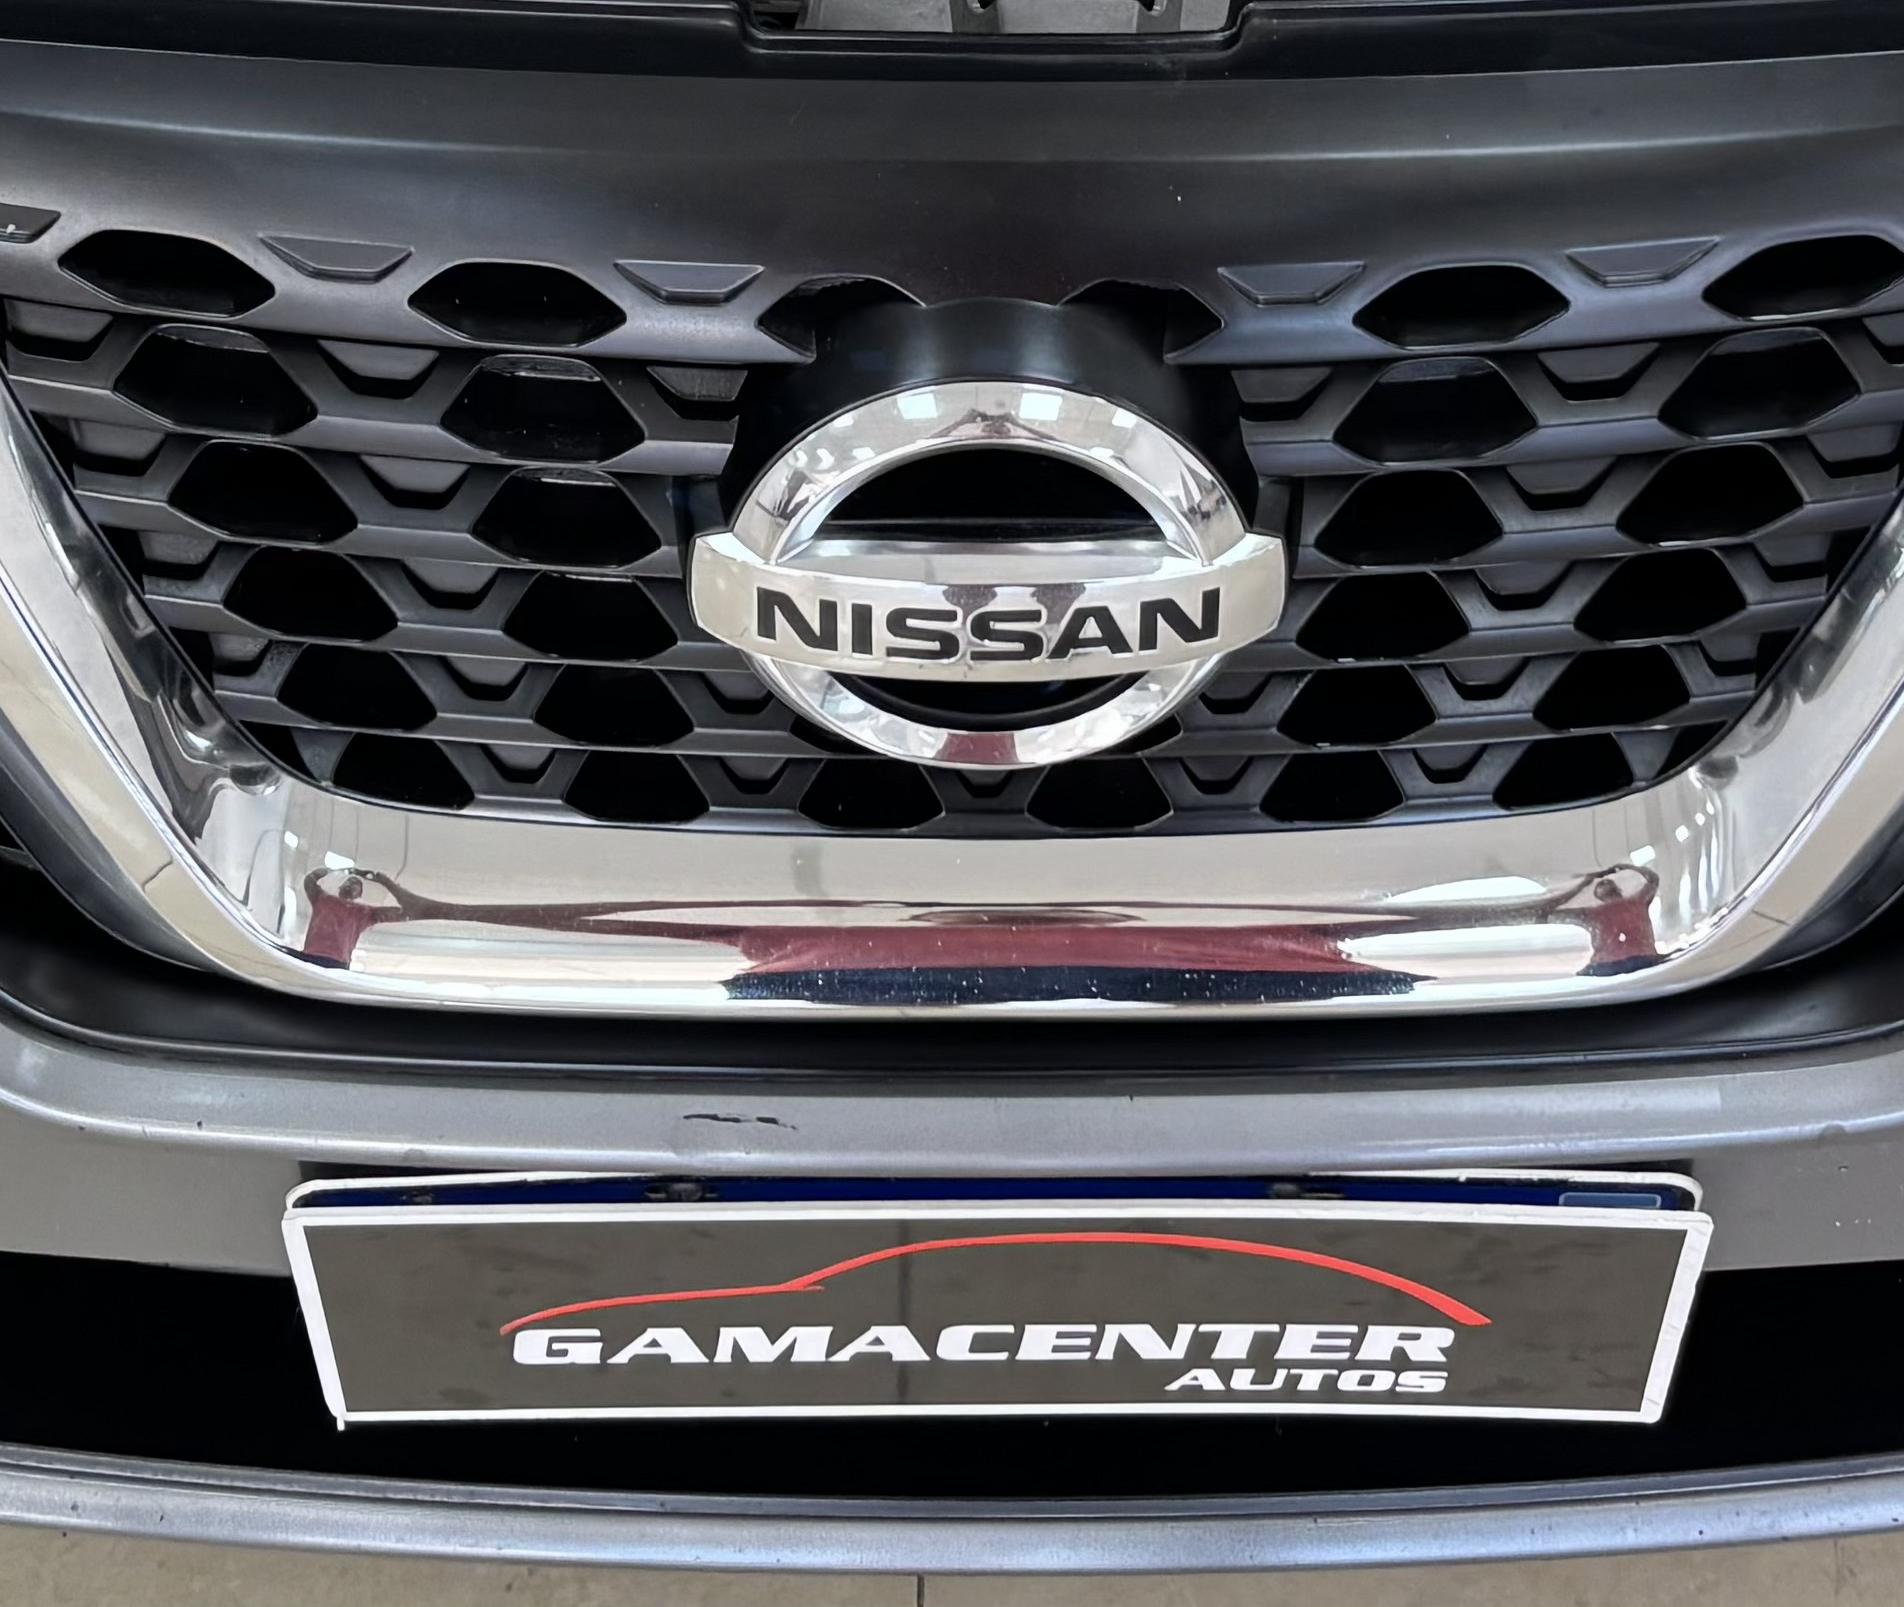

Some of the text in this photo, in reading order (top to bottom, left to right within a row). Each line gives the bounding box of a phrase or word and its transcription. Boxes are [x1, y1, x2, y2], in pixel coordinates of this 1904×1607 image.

[756, 586, 1221, 661] NISSAN
[512, 1324, 1455, 1365] GAMACENTER
[1163, 1368, 1450, 1393] AUTOS
